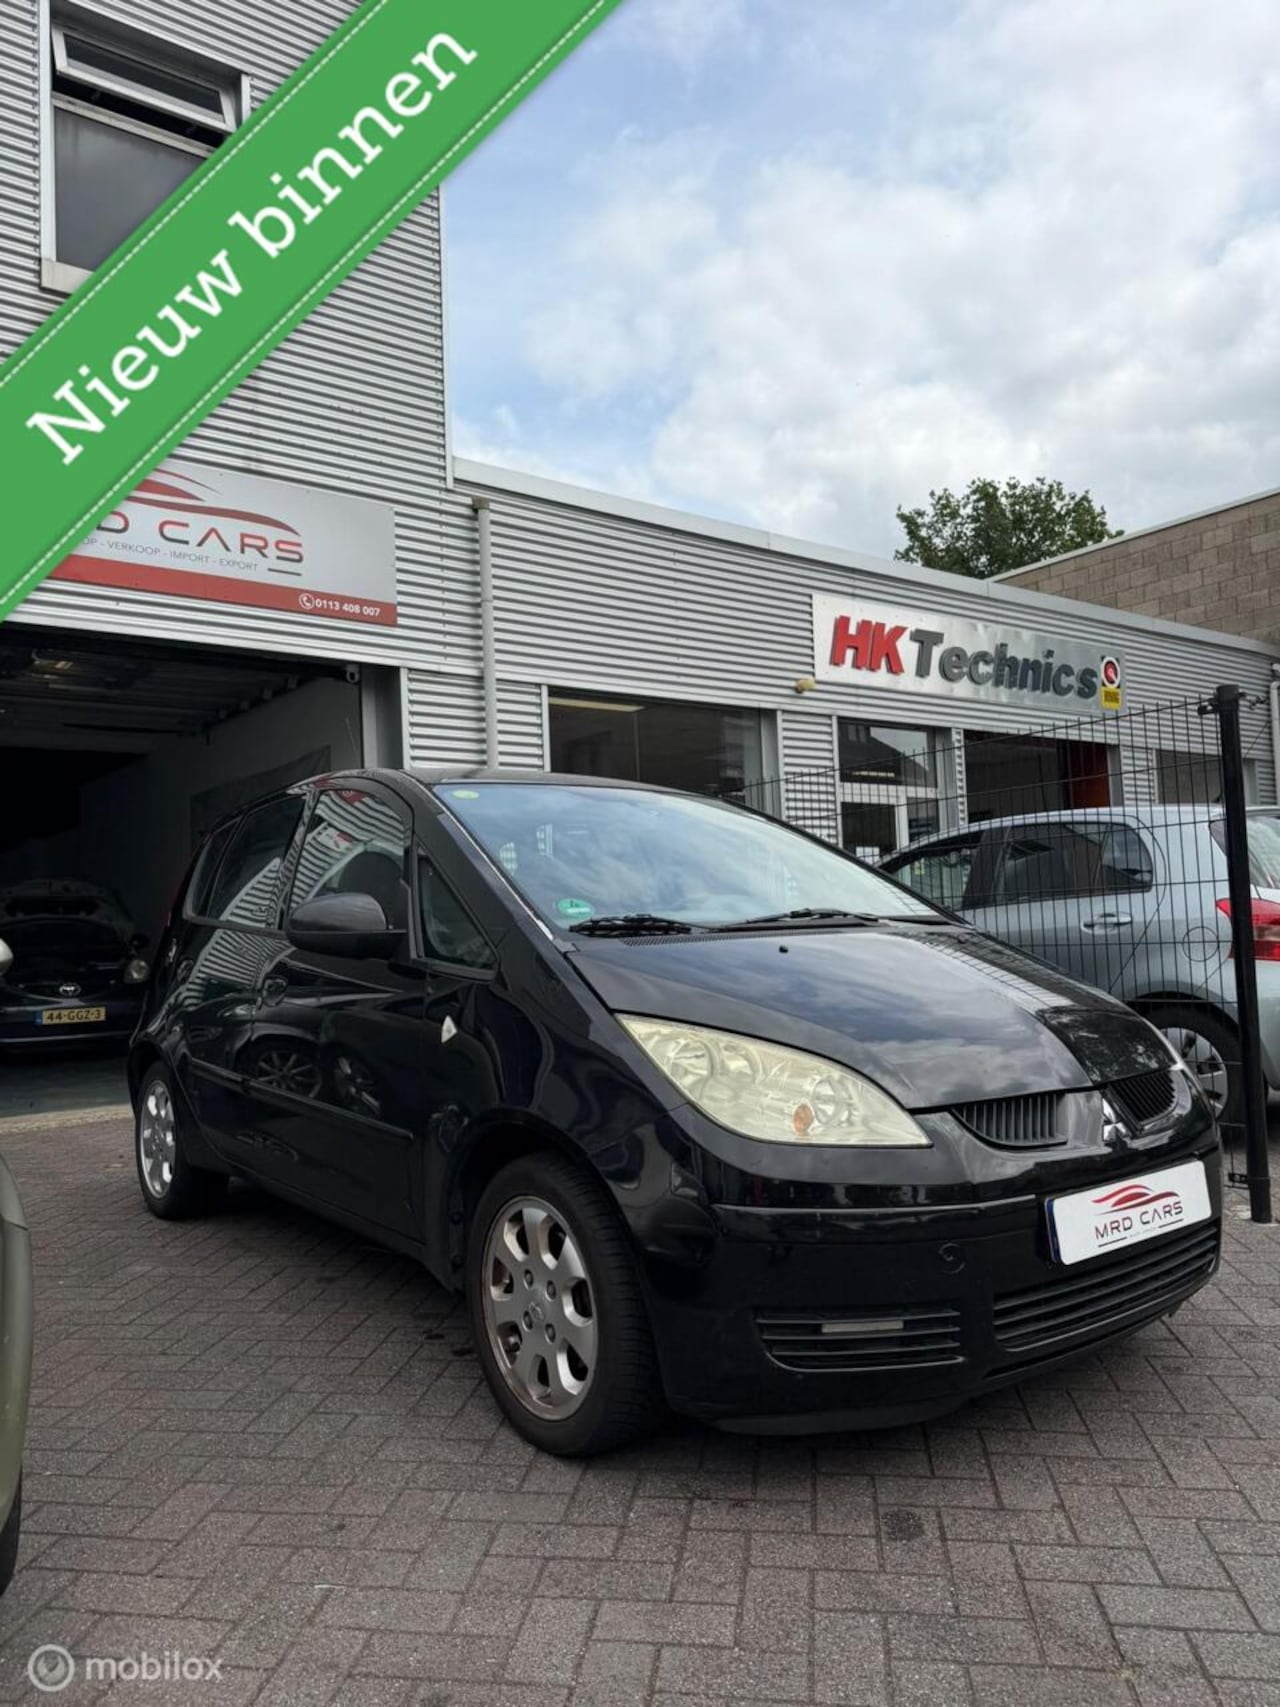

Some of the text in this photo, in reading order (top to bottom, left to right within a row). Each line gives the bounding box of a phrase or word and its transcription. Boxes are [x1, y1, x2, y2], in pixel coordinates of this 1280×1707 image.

[107, 540, 161, 554] VERKOOP
[170, 551, 209, 563] IMPORT
[219, 559, 259, 571] EXPORT
[158, 519, 304, 563] CARS
[315, 598, 381, 617] 0113 408 007
[46, 1009, 102, 1022] 44-GGZ-3
[1095, 1216, 1133, 1240] MRD
[1139, 1201, 1184, 1225] CARS
